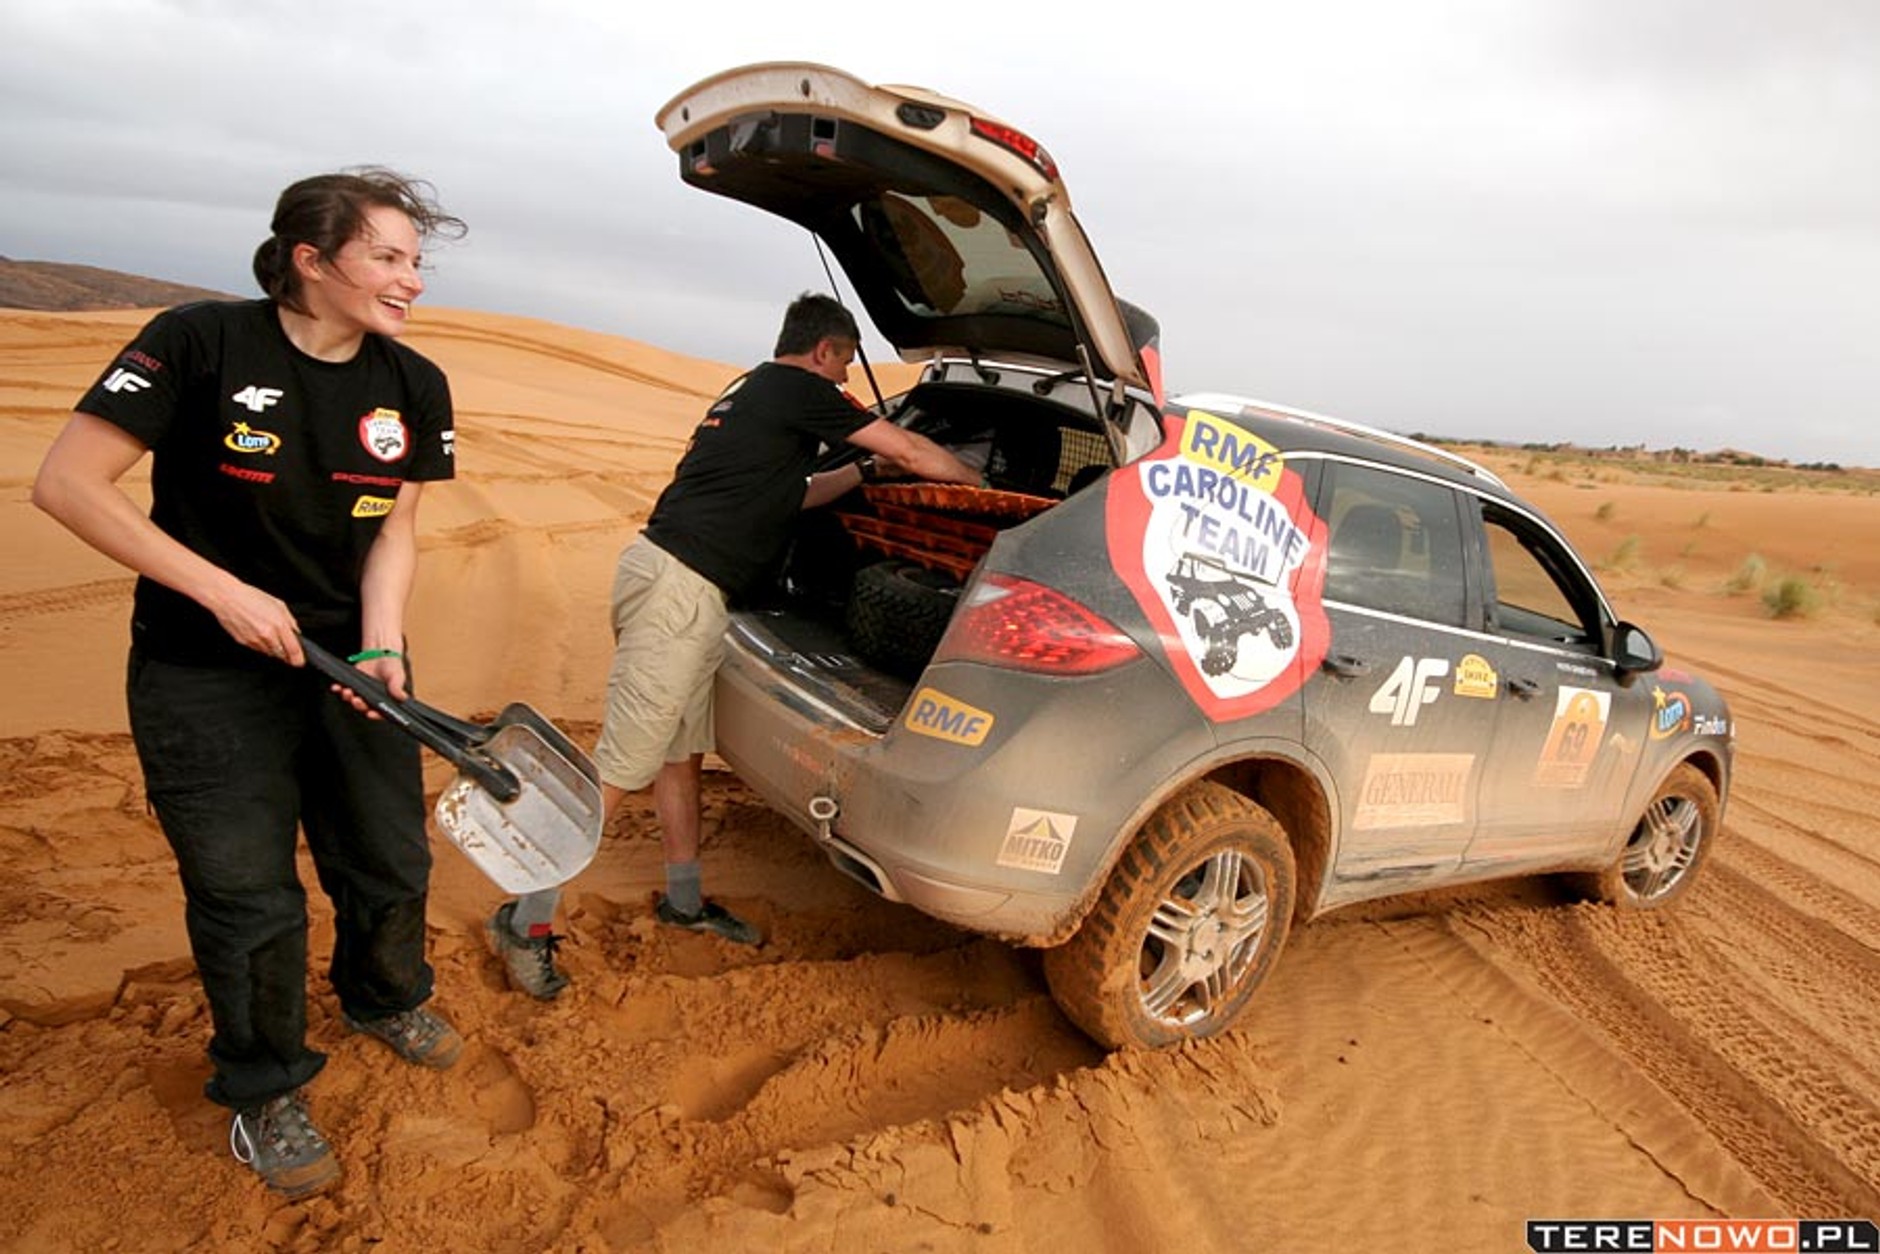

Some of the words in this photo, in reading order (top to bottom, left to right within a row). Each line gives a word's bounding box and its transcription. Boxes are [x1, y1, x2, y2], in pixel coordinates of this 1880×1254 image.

[232, 385, 284, 413] 4F
[1190, 421, 1278, 480] RMF
[1148, 464, 1304, 566] CAROLINE
[1180, 502, 1269, 576] TEAM
[912, 698, 986, 738] RMF
[1368, 656, 1449, 726] 4F
[1003, 835, 1064, 861] MITKO
